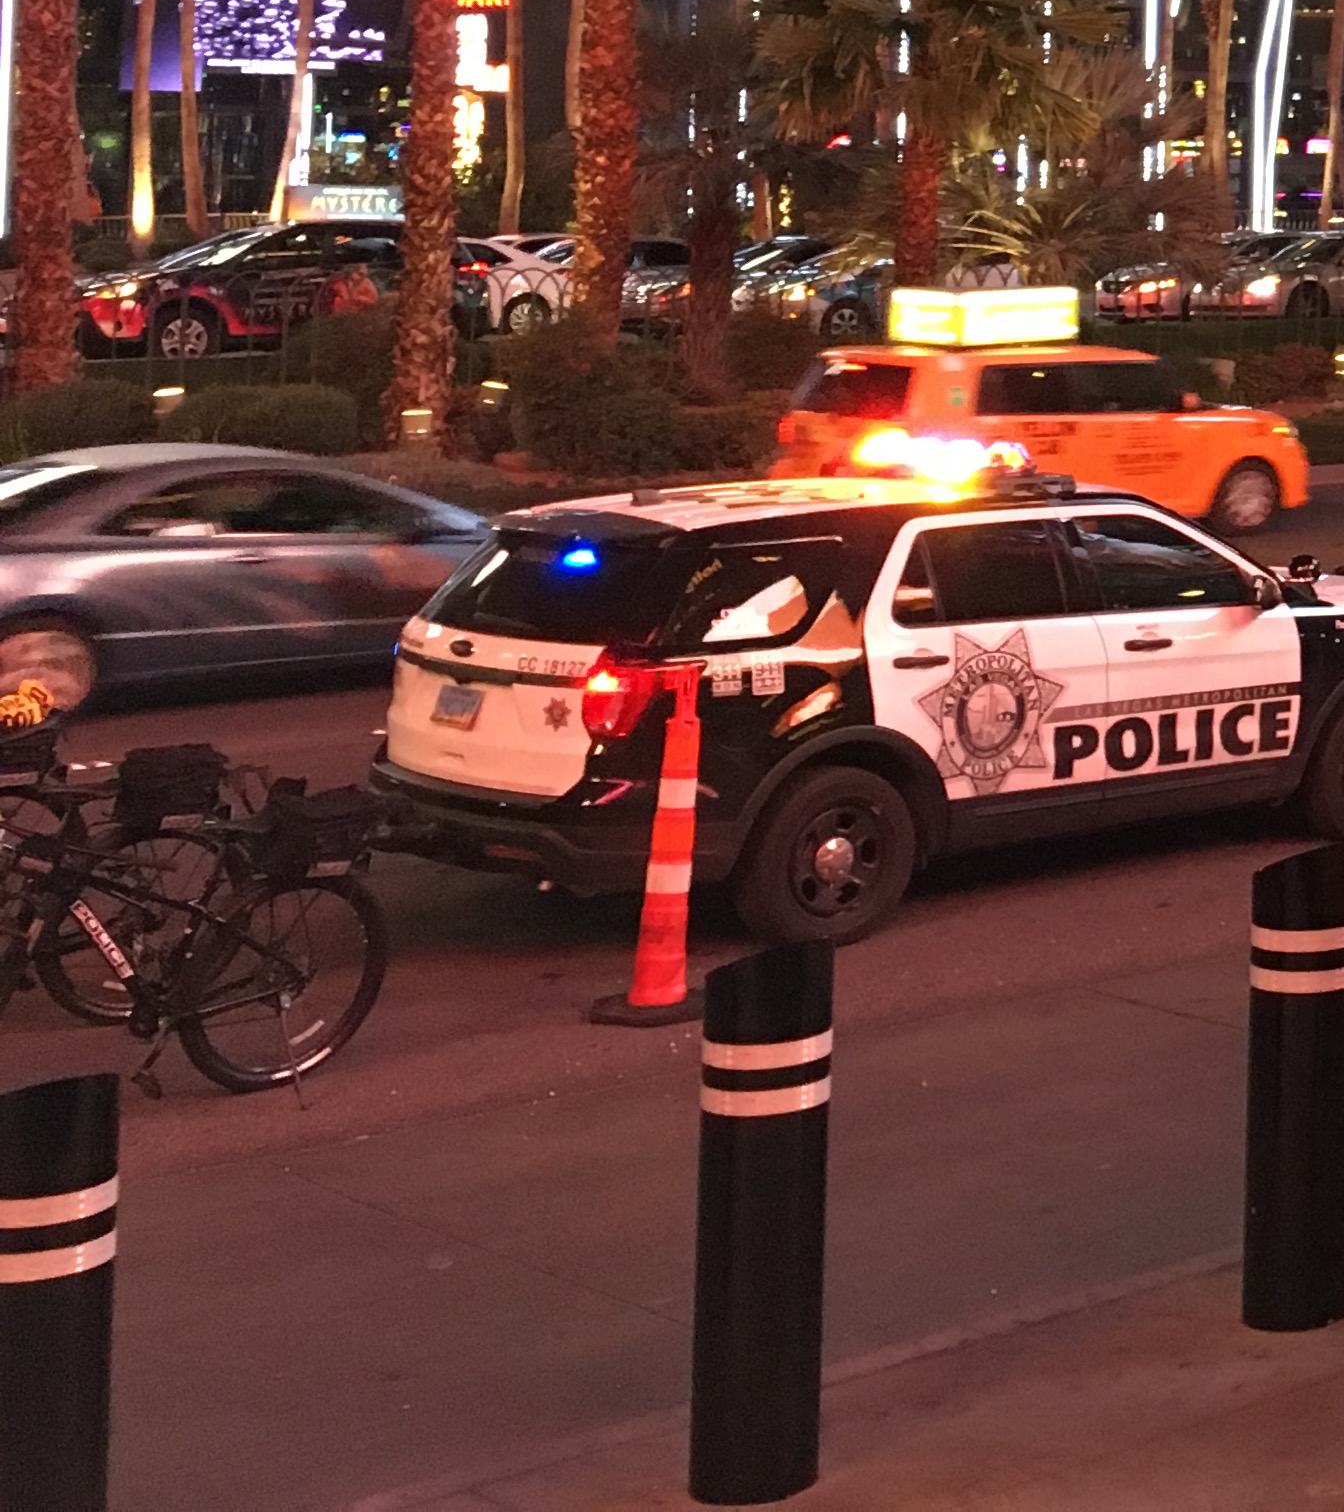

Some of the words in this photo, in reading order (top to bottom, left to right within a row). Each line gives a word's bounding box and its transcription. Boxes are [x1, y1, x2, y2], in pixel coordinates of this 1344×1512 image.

[944, 654, 1039, 717] METROPOLITAN
[1074, 705, 1104, 719] LAS
[1112, 698, 1163, 714] VEGAS
[1170, 685, 1288, 707] METROPOLITAN
[1053, 700, 1292, 780] POLICE
